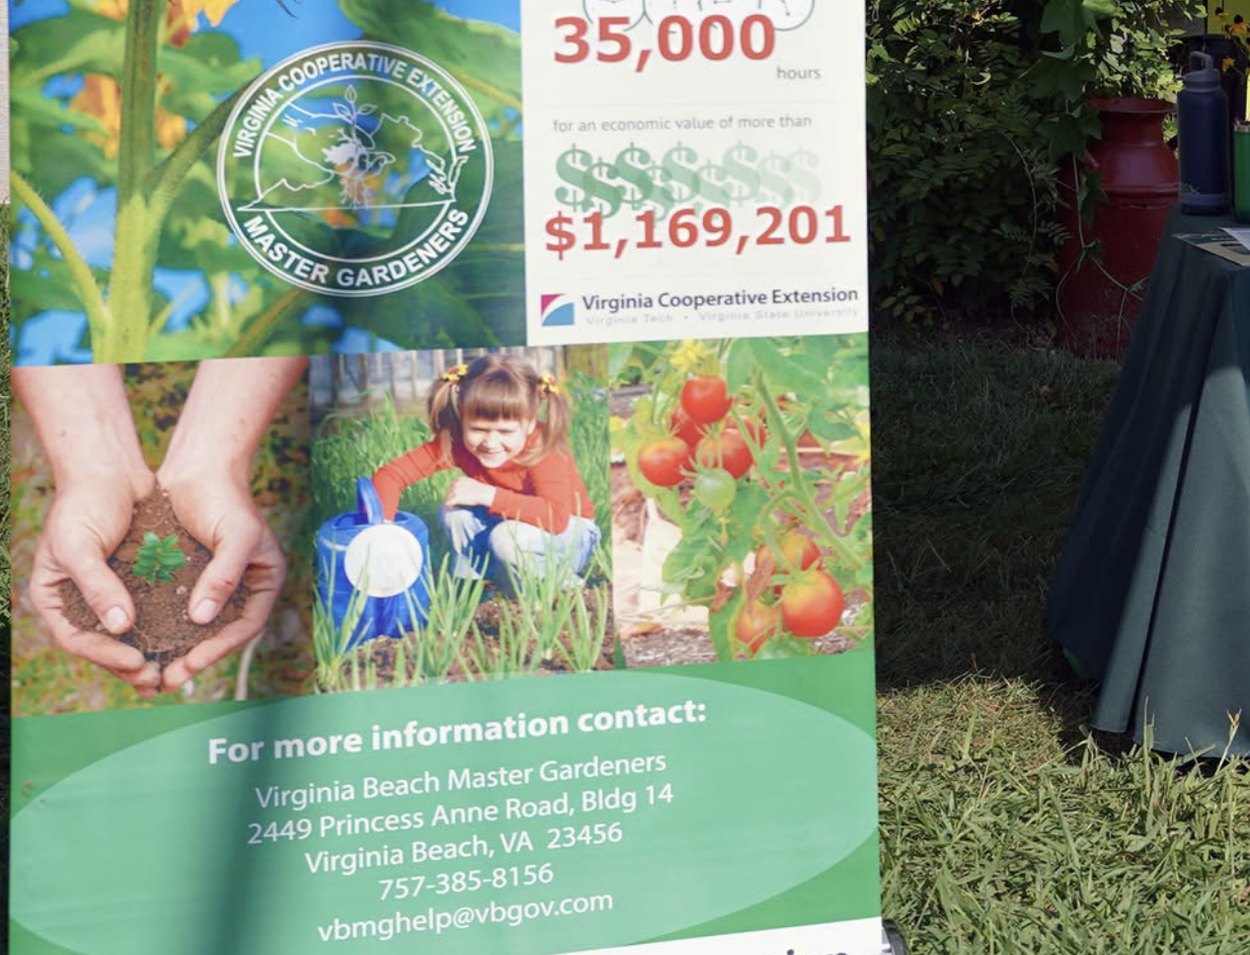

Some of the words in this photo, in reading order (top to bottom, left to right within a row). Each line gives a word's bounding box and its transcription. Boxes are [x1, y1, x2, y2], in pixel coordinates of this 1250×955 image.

[554, 14, 775, 73] 35,000
[776, 66, 821, 80] hours
[233, 85, 284, 157] VIRGINIA
[277, 52, 409, 93] COOPERATIVE
[406, 67, 477, 153] EXTENSION
[553, 118, 573, 133] for
[578, 121, 597, 133] an
[601, 117, 671, 133] economic
[674, 116, 714, 131] value
[719, 114, 734, 129] of
[738, 116, 775, 129] more
[779, 114, 812, 128] than
[243, 215, 329, 284] MASTER
[336, 208, 469, 287] GARDENERS
[545, 204, 851, 261] $1,169,201
[582, 293, 653, 313] Virginia
[658, 290, 767, 311] Cooperative
[772, 287, 858, 305] Extension
[208, 736, 266, 765] For
[275, 732, 362, 760] more
[372, 713, 569, 751] information
[577, 700, 706, 733] contact:
[255, 781, 355, 811] Virginia
[363, 771, 440, 800] Beach
[447, 763, 533, 791] Master
[540, 752, 667, 783] Gardeners
[247, 818, 313, 845] 2449
[319, 809, 425, 839] Princess
[431, 802, 499, 827] Anne
[505, 792, 575, 822] Road,
[581, 787, 638, 815] Bldg
[644, 783, 675, 806] 14
[304, 846, 404, 877] Virginia
[412, 834, 494, 864] Beach,
[499, 830, 534, 854] VA
[547, 822, 624, 850] 23456
[379, 863, 555, 901] 757-385-8156
[317, 892, 614, 942] vbmghelp@vbgov.com
